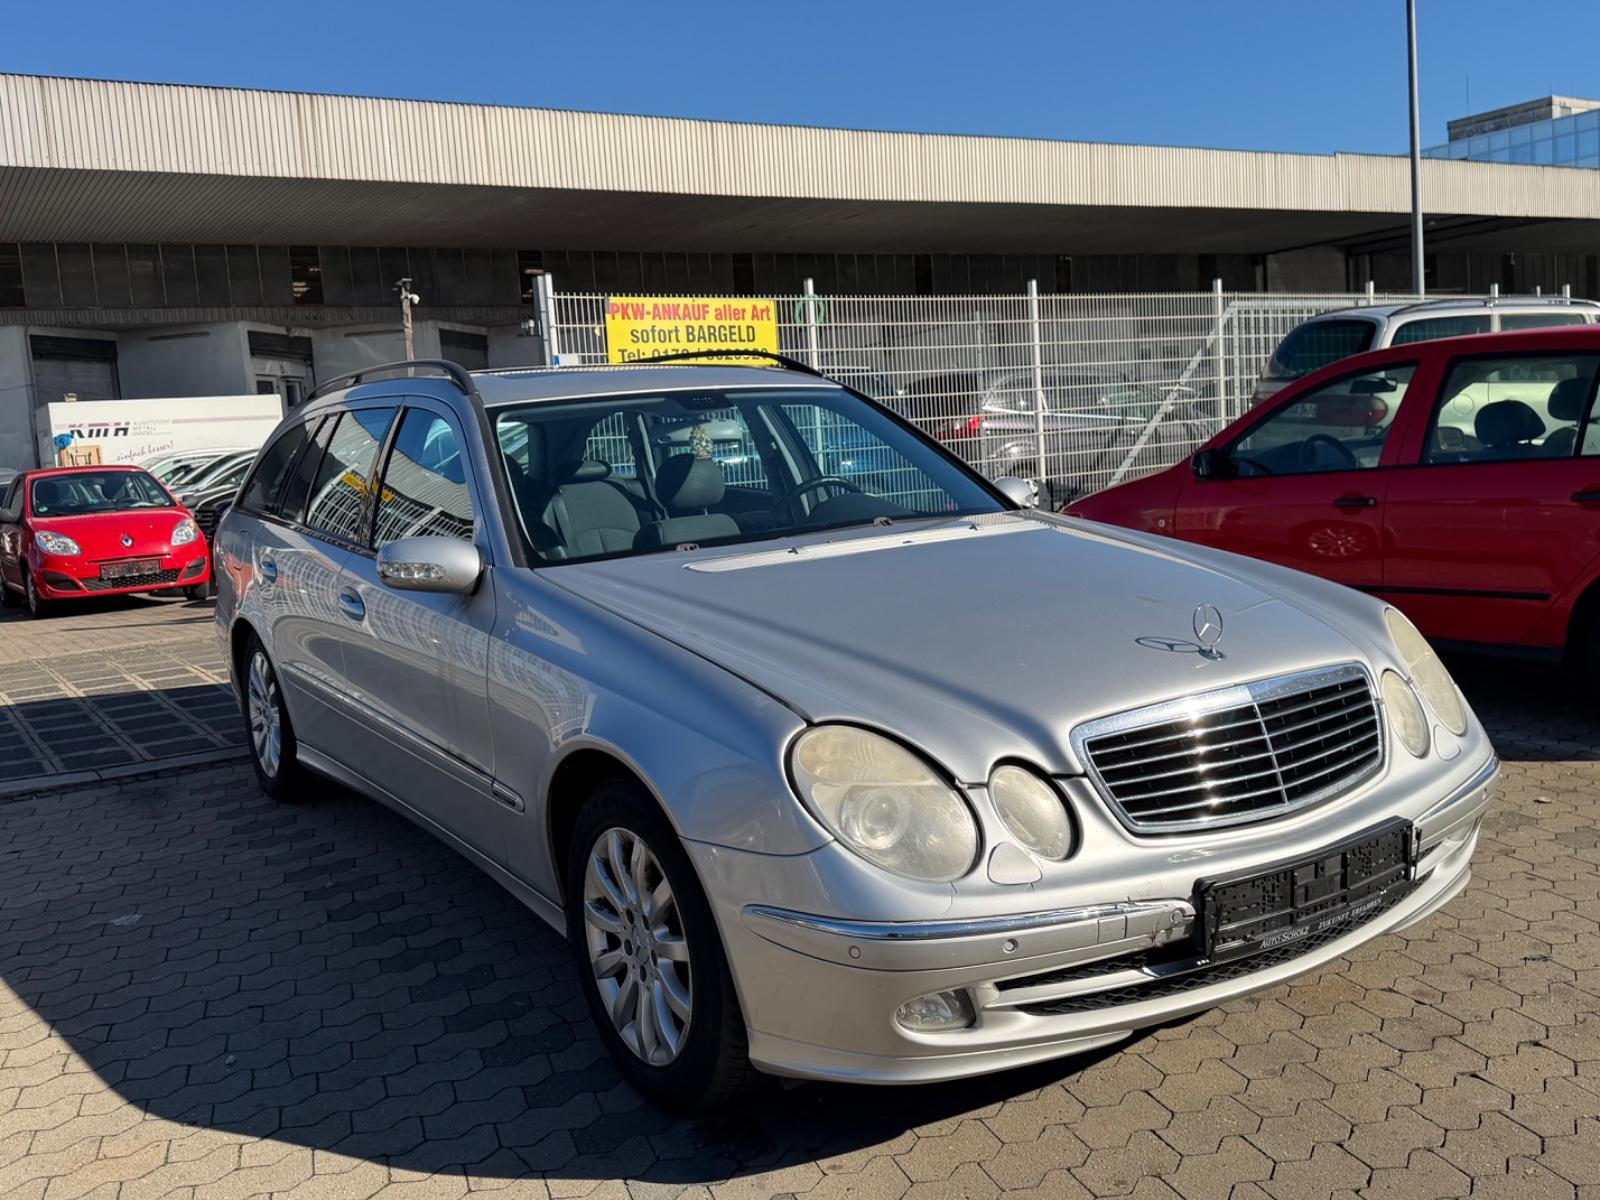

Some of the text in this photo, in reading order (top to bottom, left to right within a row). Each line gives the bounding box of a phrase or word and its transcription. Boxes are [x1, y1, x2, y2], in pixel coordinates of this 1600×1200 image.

[609, 302, 772, 322] PKW-ANKAUF aller Art
[630, 325, 756, 344] sofort BARGELD
